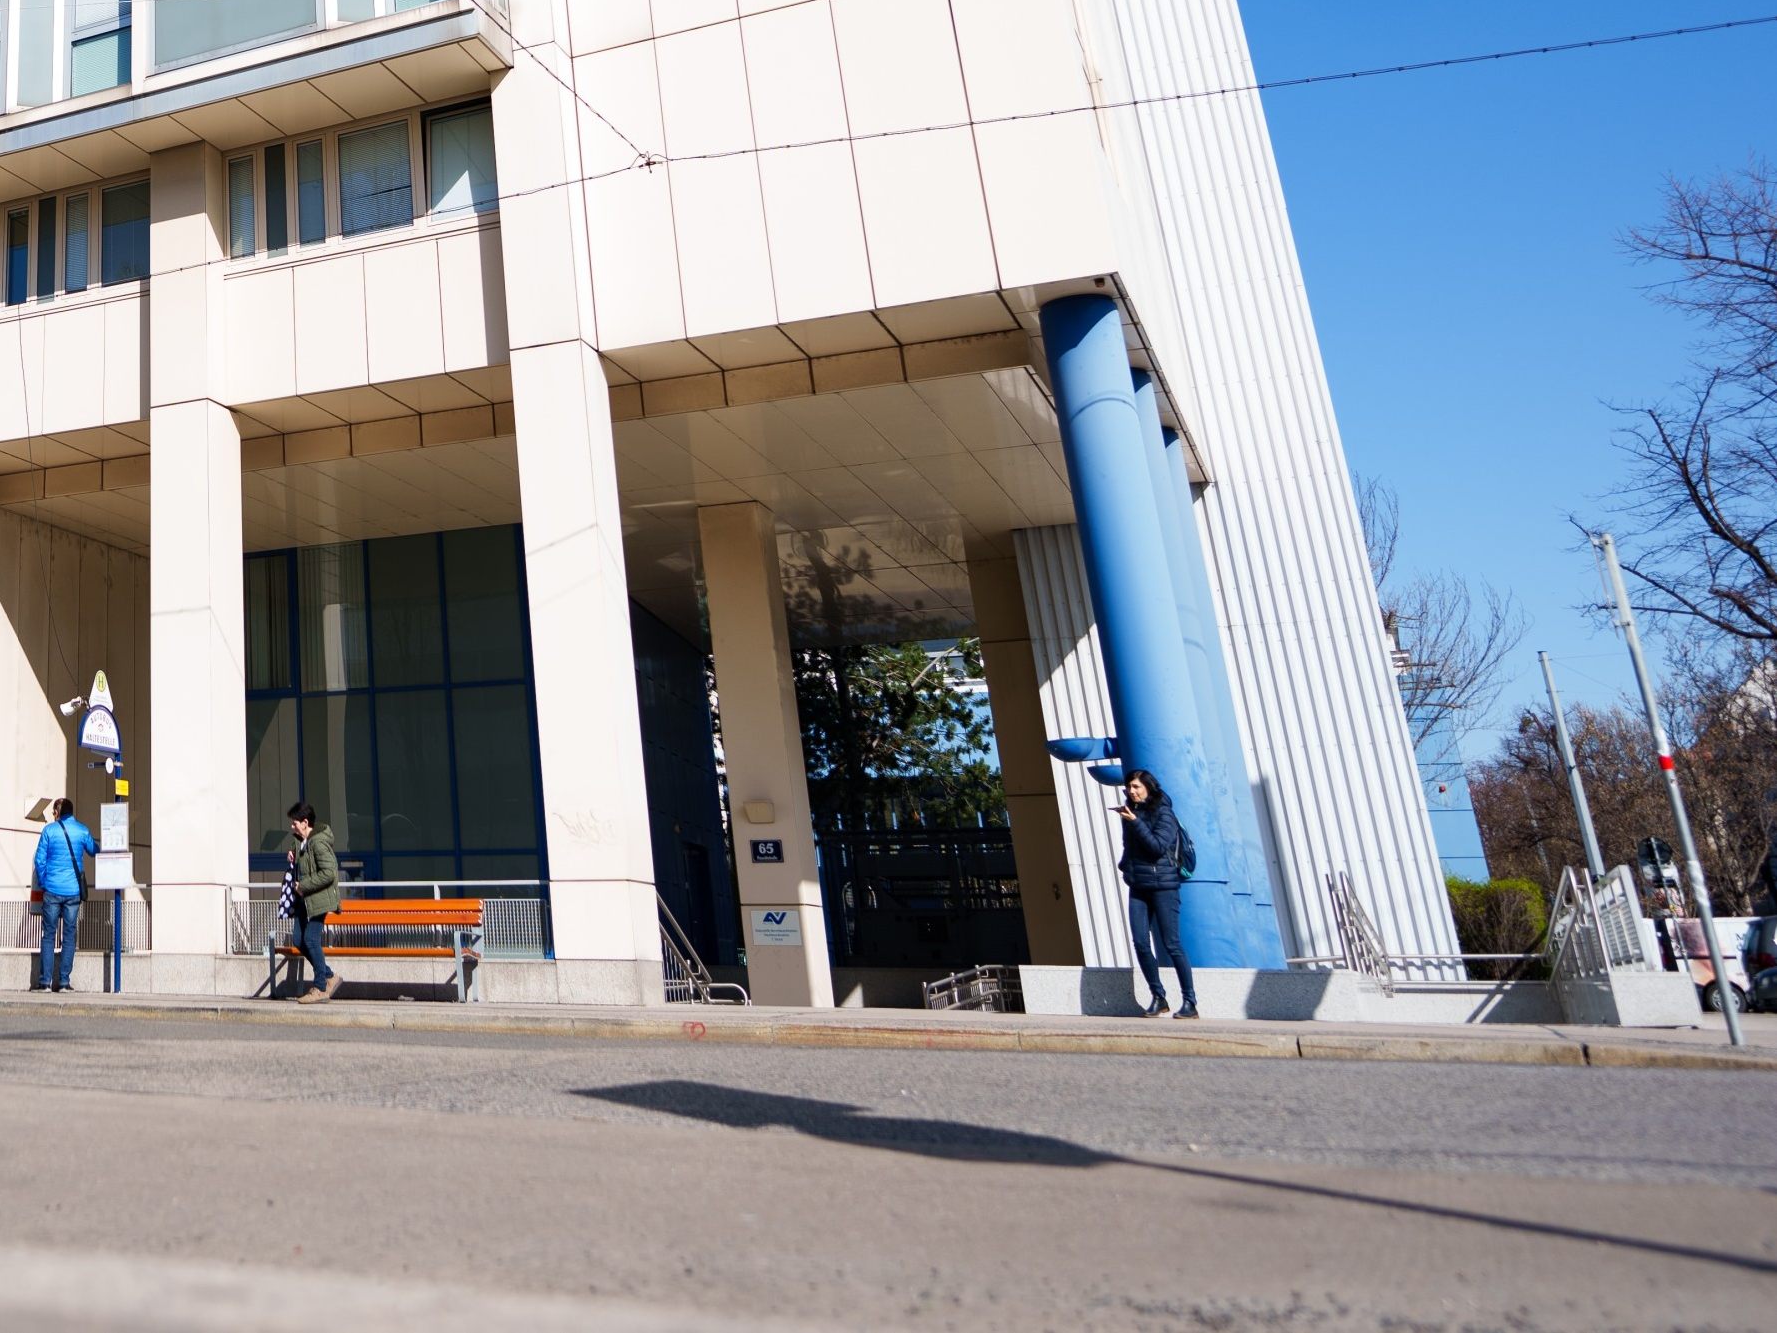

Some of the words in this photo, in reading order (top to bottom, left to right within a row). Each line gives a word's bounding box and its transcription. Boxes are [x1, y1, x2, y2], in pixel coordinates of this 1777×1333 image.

[90, 712, 112, 729] AUTOBUS
[85, 733, 115, 746] HALTESTELLE
[758, 843, 774, 854] 65
